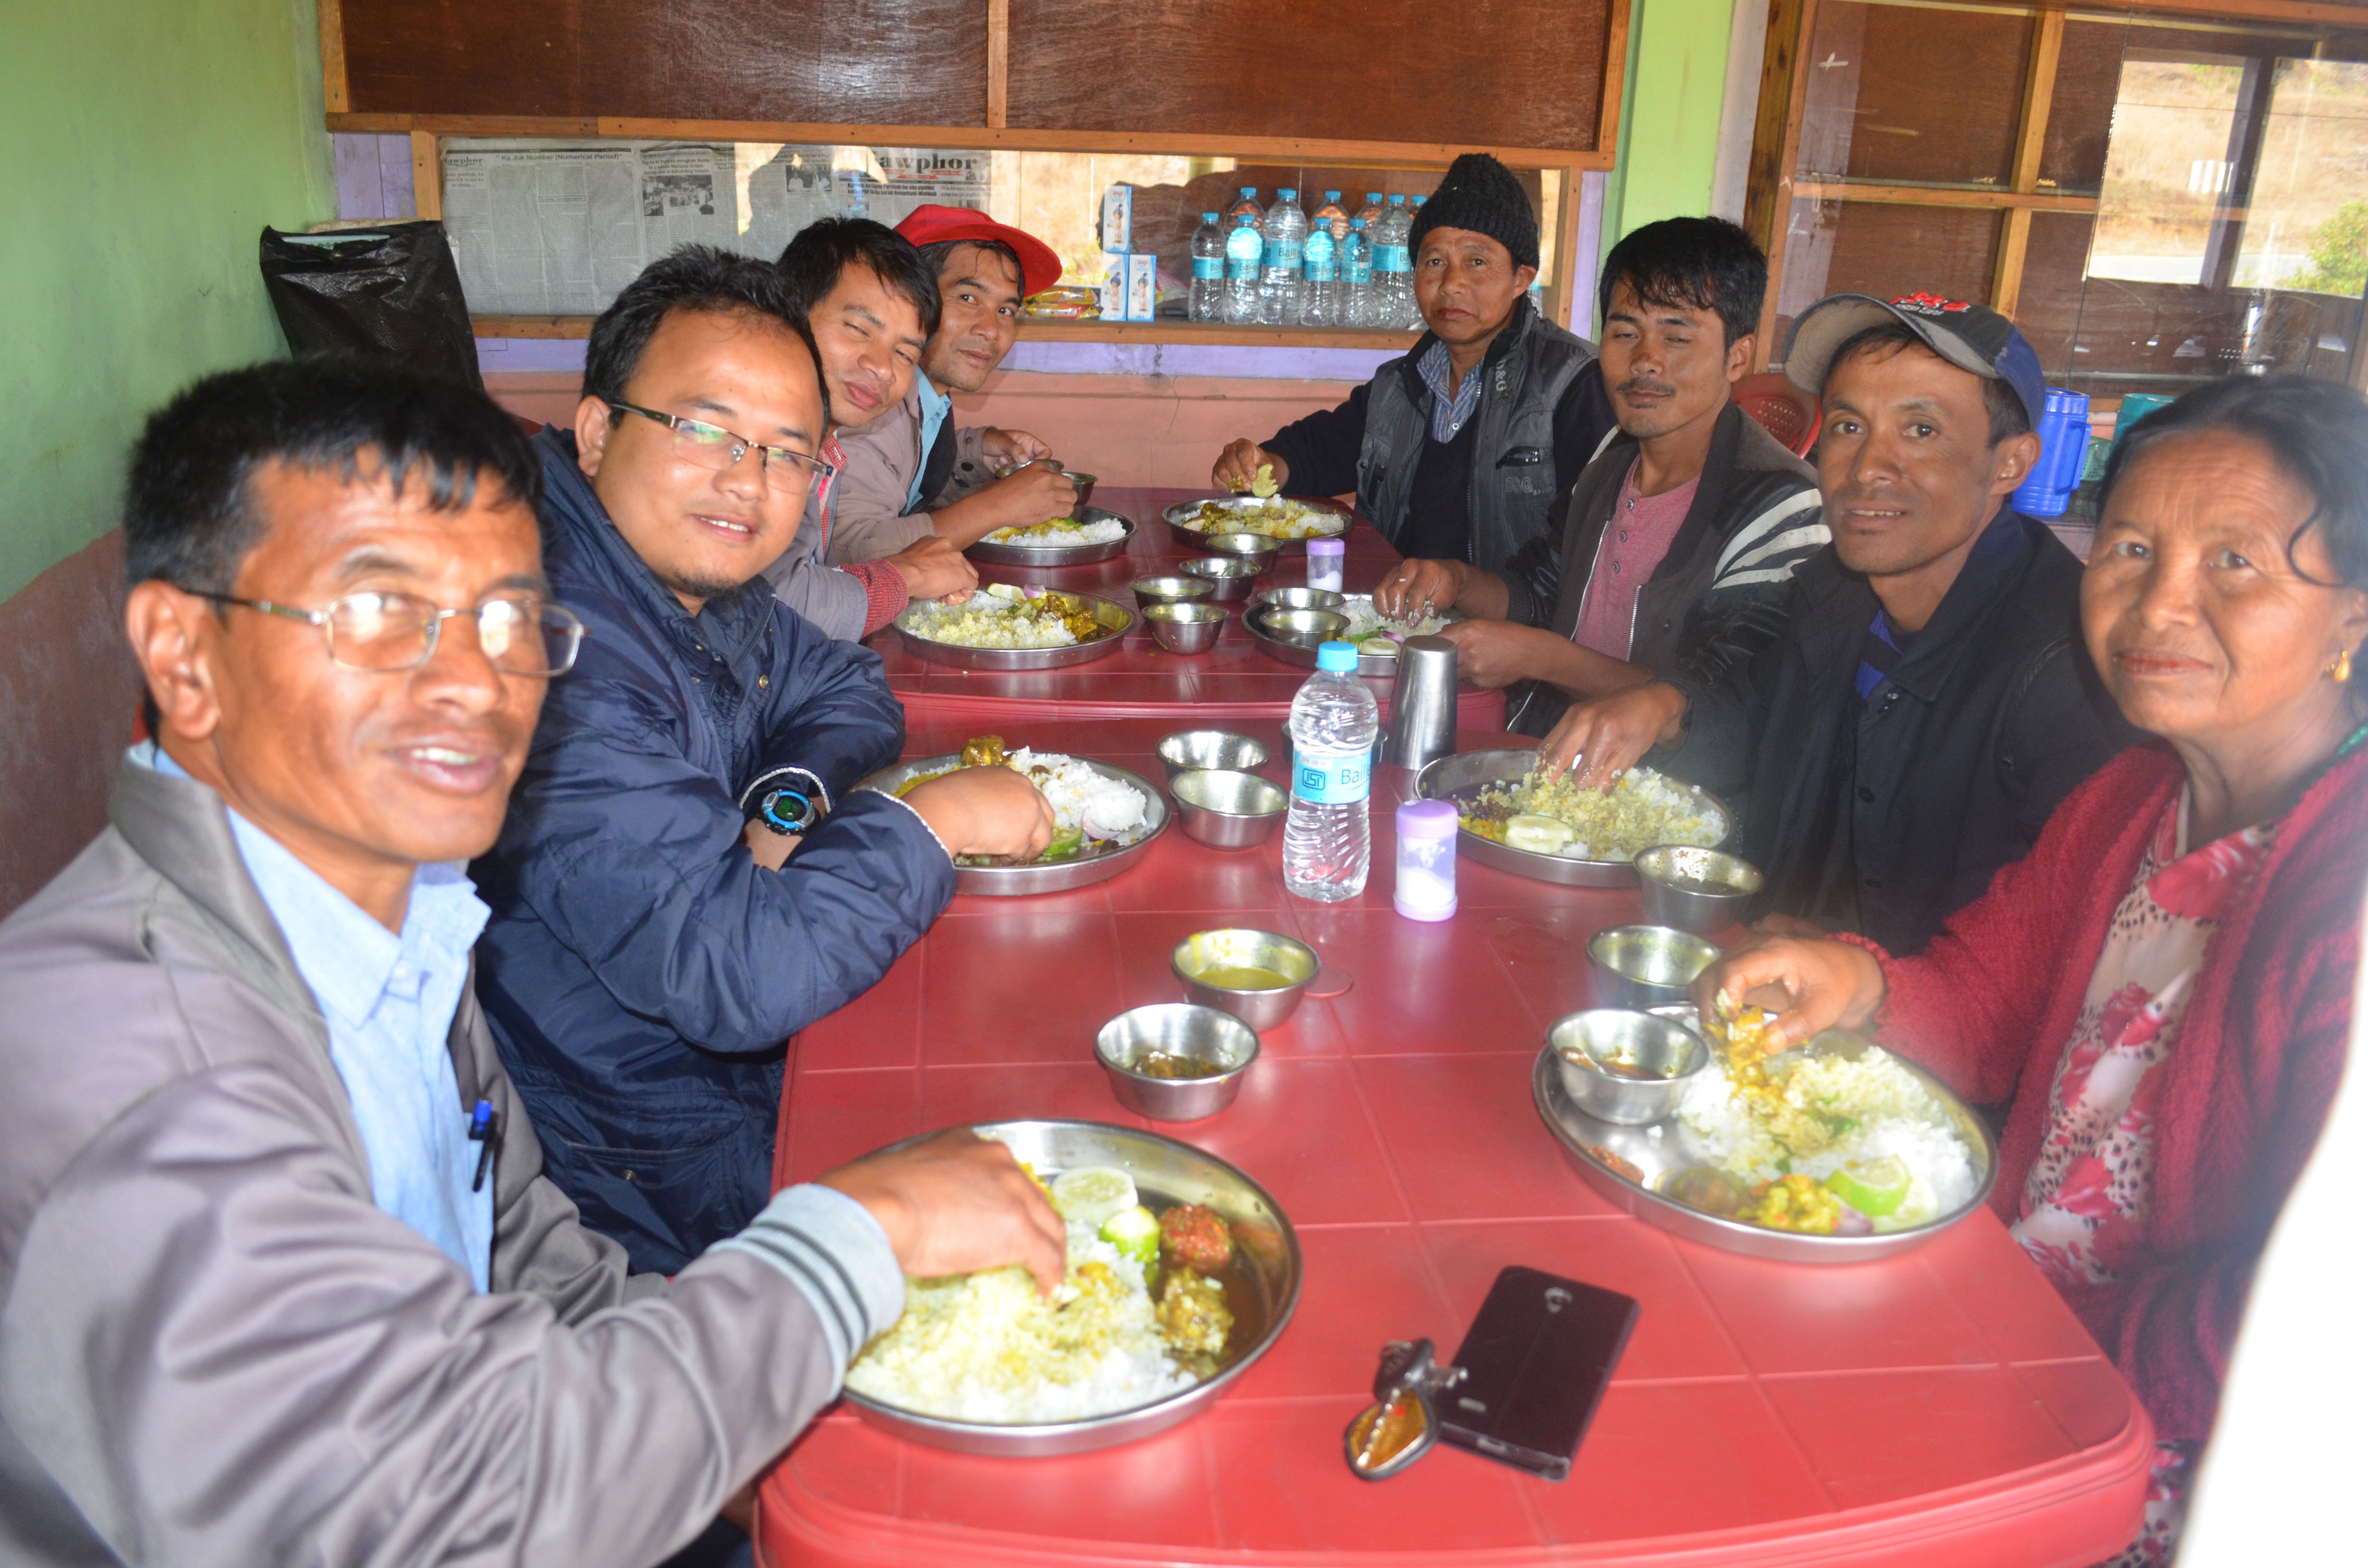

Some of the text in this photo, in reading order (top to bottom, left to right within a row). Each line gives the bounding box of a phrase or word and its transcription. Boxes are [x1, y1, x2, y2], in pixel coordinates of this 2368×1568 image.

[872, 150, 977, 174] awphor
[1495, 359, 1506, 391] D&G
[1505, 476, 1533, 493] D&G
